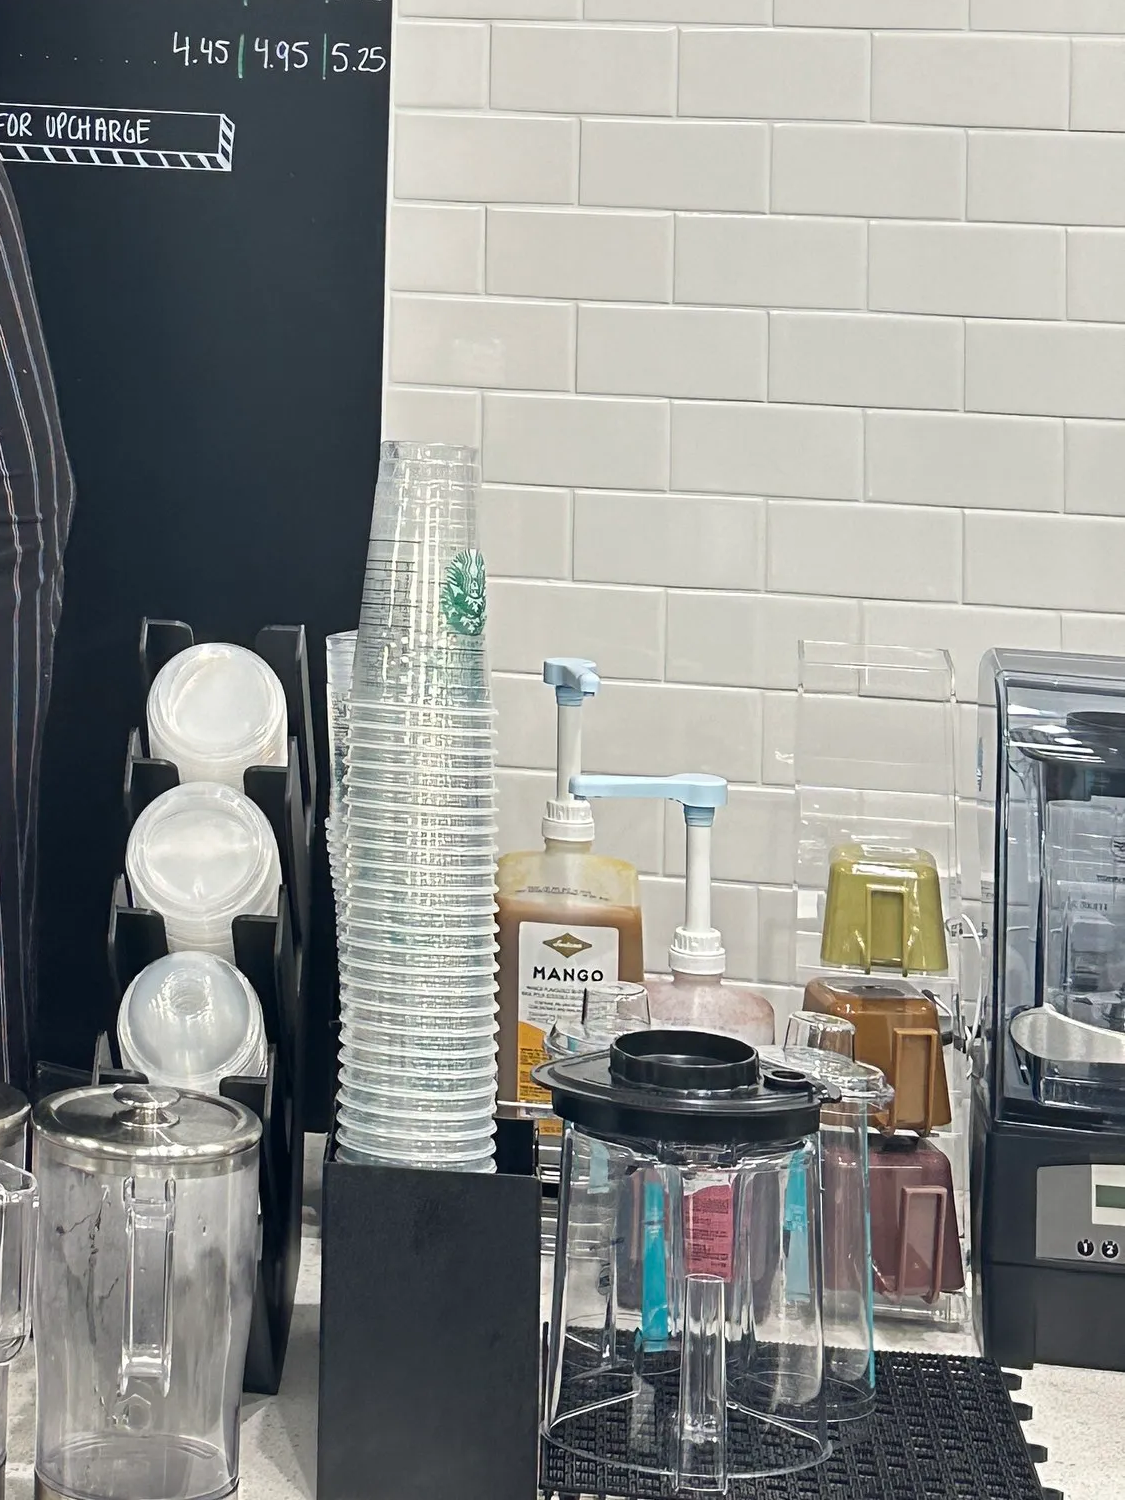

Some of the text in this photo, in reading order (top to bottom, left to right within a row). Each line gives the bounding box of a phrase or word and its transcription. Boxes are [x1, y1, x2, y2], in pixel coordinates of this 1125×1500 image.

[173, 31, 387, 74] 4.45 4.95 5.25
[45, 111, 151, 144] UPCHARGE
[532, 966, 604, 982] MANGO
